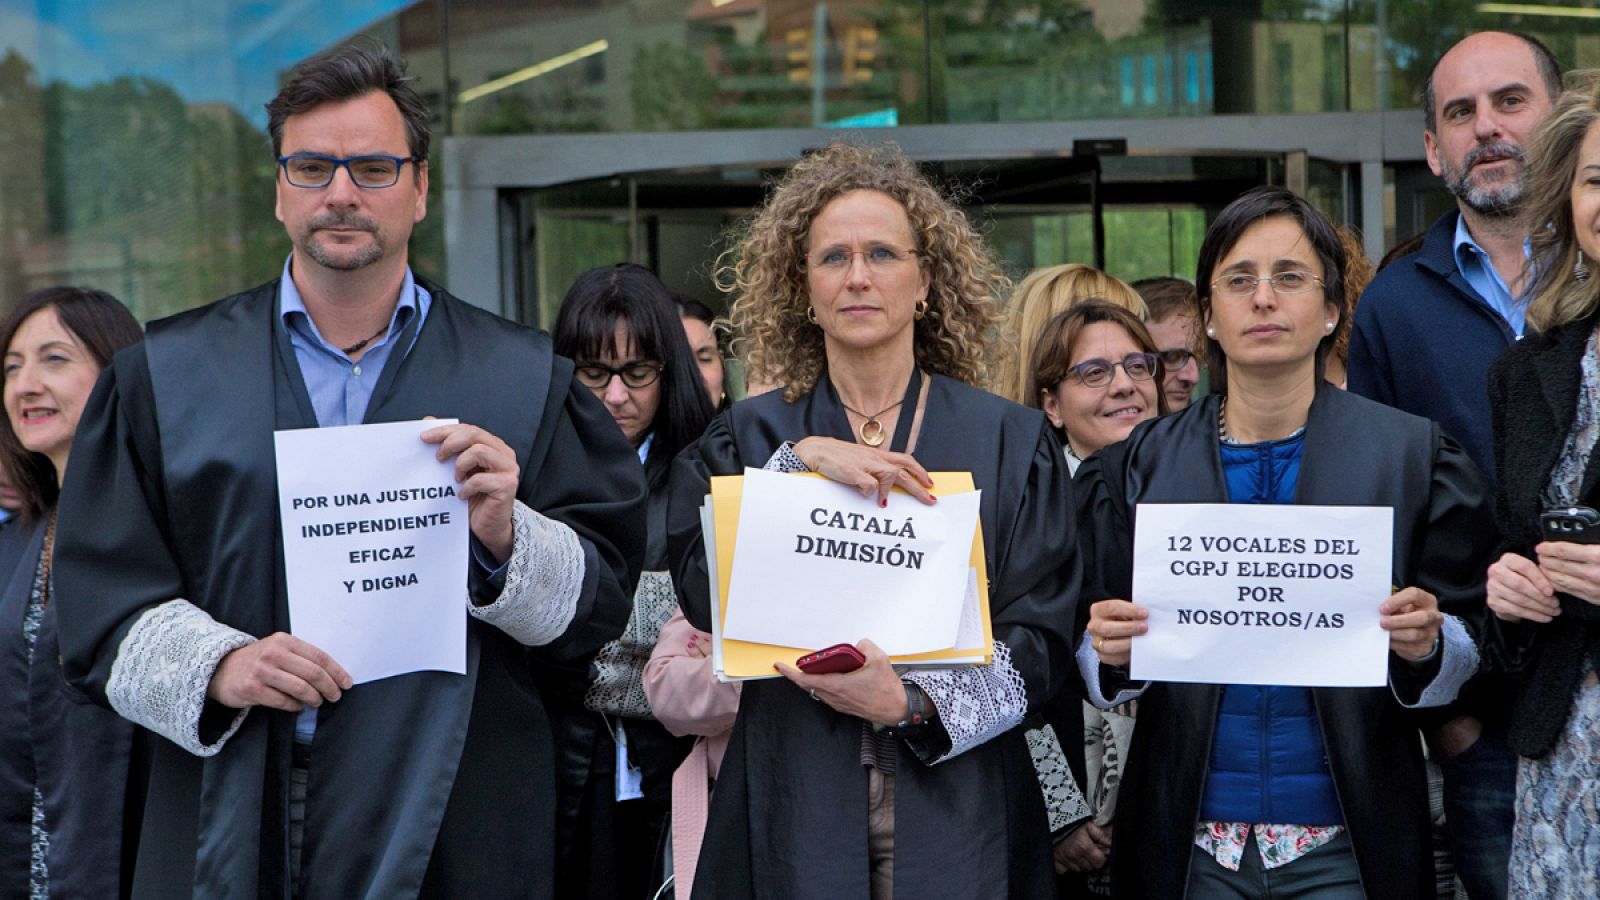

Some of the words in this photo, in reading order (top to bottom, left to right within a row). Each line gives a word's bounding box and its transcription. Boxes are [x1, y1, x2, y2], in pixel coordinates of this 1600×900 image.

[292, 496, 329, 510] POR
[334, 493, 371, 507] UNA
[375, 485, 456, 504] JUSTICIA
[301, 511, 451, 538] INDEPENDIENTE
[810, 507, 917, 539] CATALÁ
[349, 545, 416, 564] EFICAZ
[794, 534, 925, 570] DIMISIÓN
[1167, 536, 1193, 552] 12
[1199, 536, 1306, 554] VOCALES
[1314, 539, 1360, 556] DEL
[1170, 560, 1229, 577] CGPJ
[1236, 562, 1354, 580] ELEGIDOS
[343, 580, 355, 593] Y
[362, 572, 419, 592] DIGNA
[1237, 586, 1285, 603] POR
[1176, 609, 1345, 630] NOSOTROS/AS
